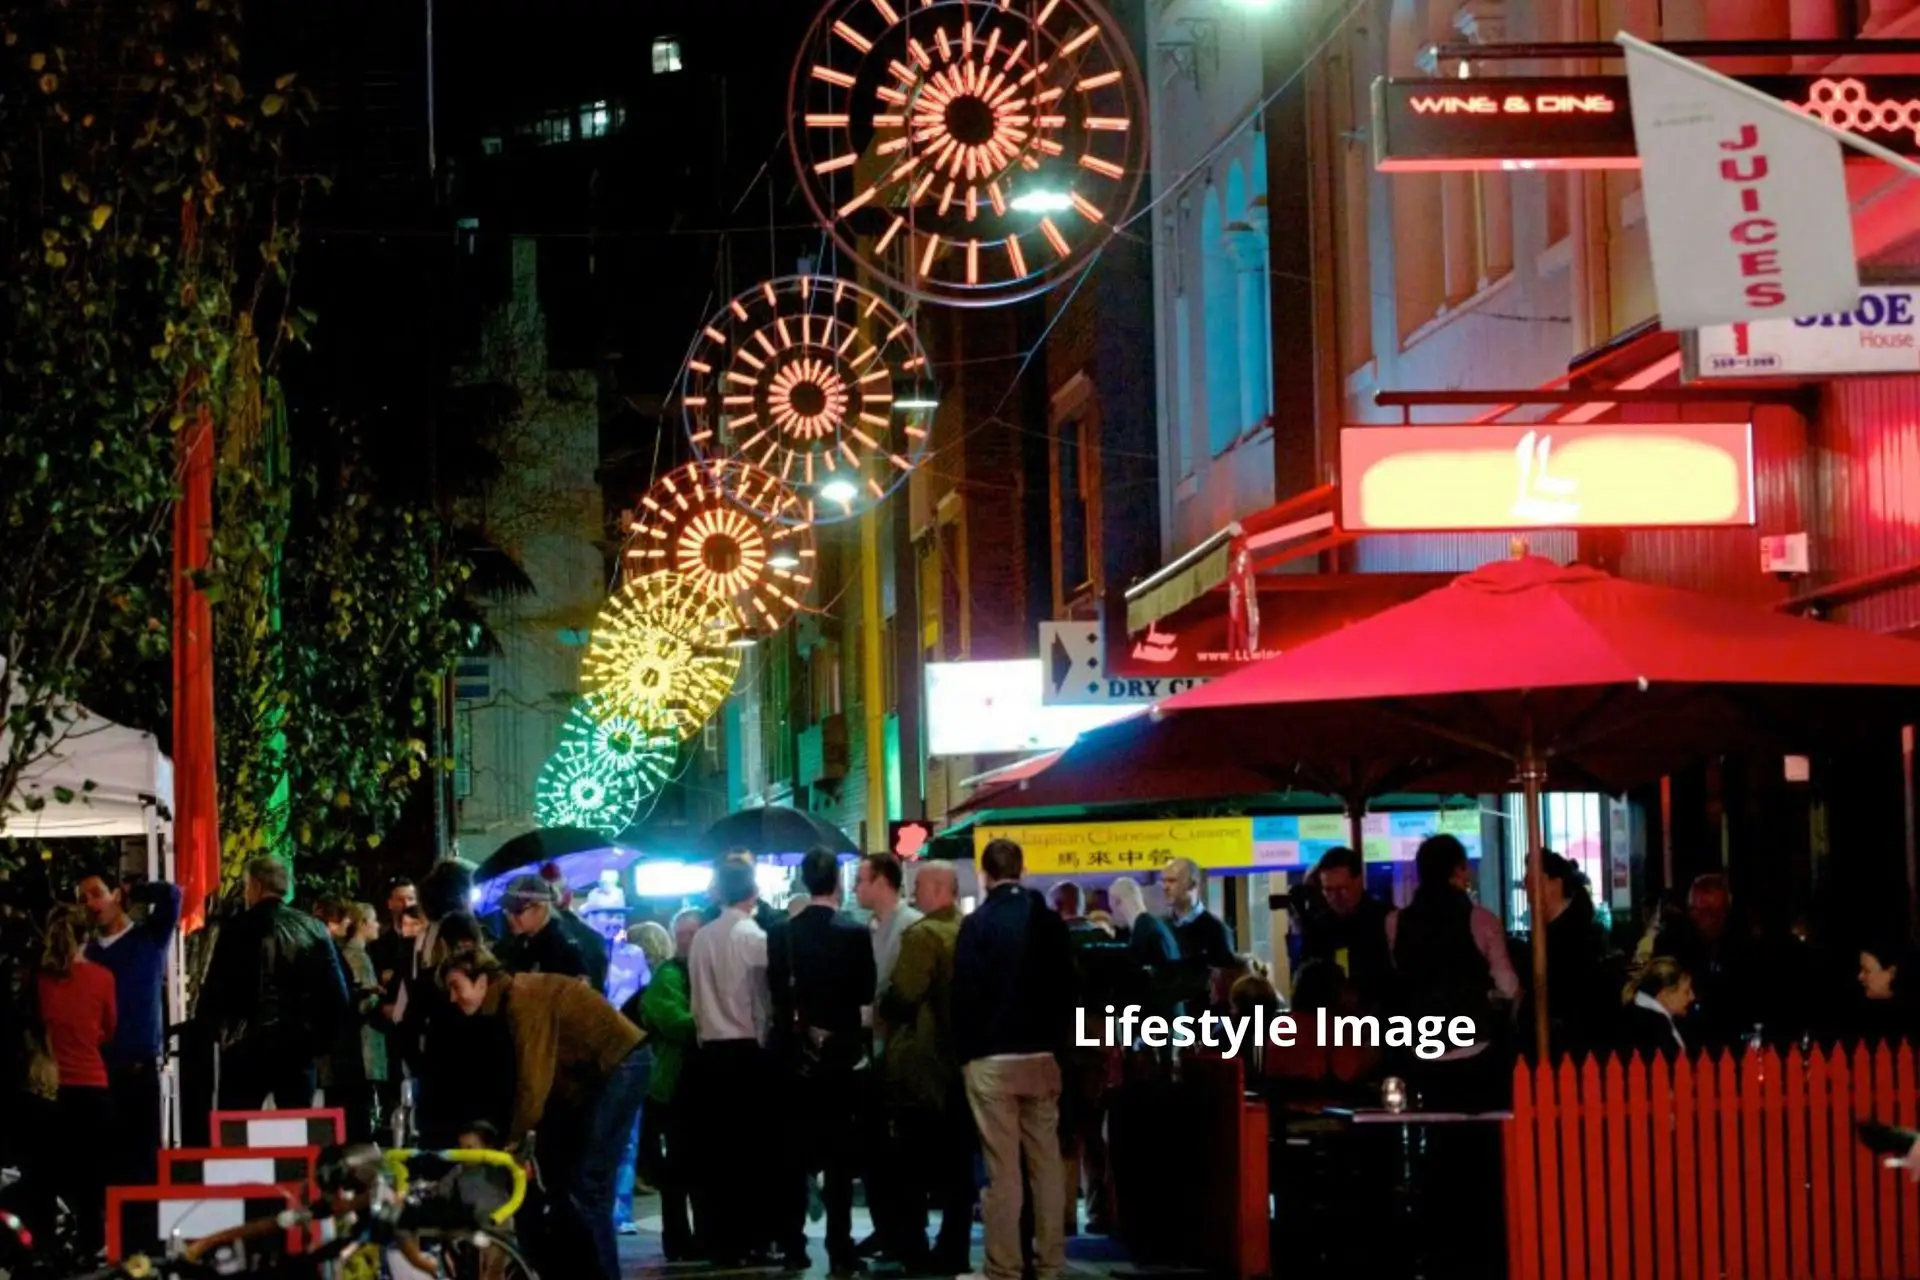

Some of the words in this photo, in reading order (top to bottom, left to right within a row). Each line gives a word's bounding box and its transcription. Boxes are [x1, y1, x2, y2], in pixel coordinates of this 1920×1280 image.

[1409, 96, 1498, 114] WINE
[1503, 96, 1531, 113] &
[1536, 95, 1615, 113] DINE
[1718, 123, 1786, 308] JUICES
[1859, 330, 1914, 348] House
[1108, 679, 1161, 697] DRY
